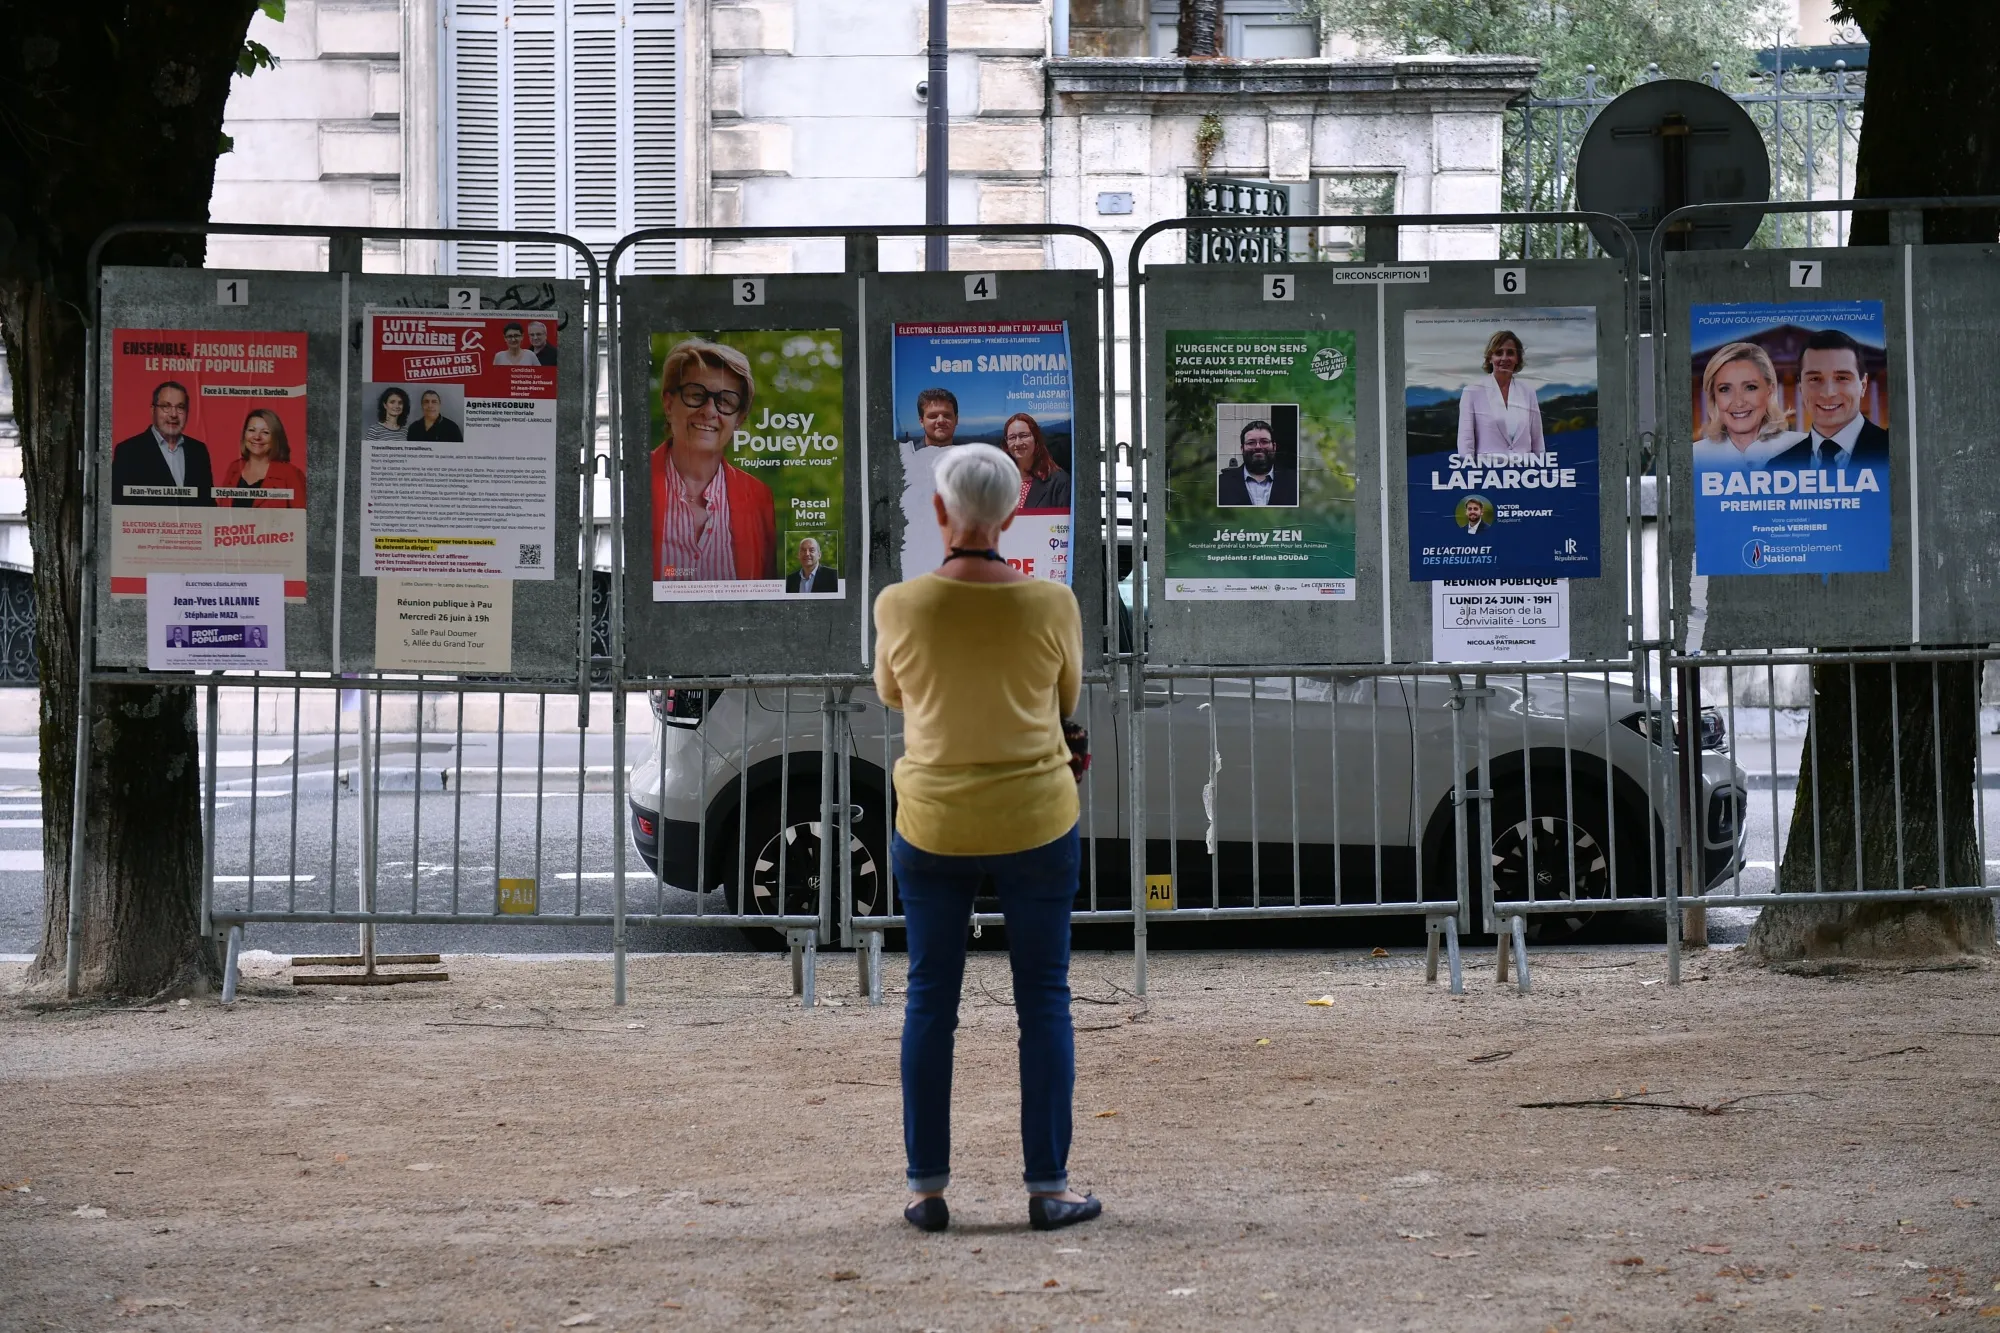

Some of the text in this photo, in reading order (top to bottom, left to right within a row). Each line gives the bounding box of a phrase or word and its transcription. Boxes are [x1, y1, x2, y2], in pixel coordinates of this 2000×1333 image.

[1336, 271, 1427, 280] CIRCONSCRIPTION 1
[1799, 265, 1813, 285] 7
[974, 277, 988, 297] 4
[1502, 272, 1517, 292] 6
[227, 282, 237, 302] 1
[742, 282, 756, 303] 3
[1272, 279, 1285, 298] 5
[457, 290, 472, 309] 2
[1735, 315, 1797, 324] GOUVERNEMENT
[1832, 313, 1875, 321] NATIONALE
[382, 320, 426, 332] LUTTE
[899, 325, 932, 334] ÉLECTIONS
[934, 325, 977, 334] LÉGISLATIVES
[1032, 324, 1036, 332] 7
[1038, 324, 1062, 332] JUILLET
[382, 331, 456, 345] OUVRIÈRE
[123, 342, 297, 358] ENSEMBLE, FAISONS GAGNER
[1238, 344, 1251, 352] DU
[1255, 344, 1277, 352] BON
[1280, 344, 1307, 352] SENS
[411, 355, 472, 367] LE CAMP DES
[931, 356, 973, 373] Jean
[1176, 355, 1294, 365] FACE AUX 3 EXTRÊMES
[145, 358, 275, 373] LE FRONT POPULAIRE
[407, 365, 477, 378] TRAVAILLEURS
[1201, 368, 1243, 376] République,
[218, 387, 222, 395] à
[264, 388, 288, 396] Bardella
[1007, 390, 1034, 400] Justine
[466, 401, 534, 410] Agnès HEGOBURU
[1028, 401, 1070, 412] Suppléante
[756, 408, 814, 434] Josy
[733, 430, 838, 456] Poueyto
[1449, 452, 1558, 469] SANDRINE
[1432, 469, 1576, 490] LAFARGUE
[1702, 468, 1880, 496] BARDELLA
[129, 488, 191, 496] Jean-Yves LALANNE
[216, 489, 248, 498] Stéphanie
[791, 498, 830, 508] Pascal
[1720, 498, 1860, 512] PREMIER MINISTRE
[795, 510, 826, 520] Mora
[1512, 509, 1553, 517] PROYART
[214, 524, 256, 536] FRONT
[1752, 525, 1785, 533] François
[1213, 529, 1302, 545] Jérémy ZEN
[1217, 542, 1238, 550] général
[1423, 547, 1435, 555] DE
[1480, 546, 1492, 554] ET
[1764, 544, 1842, 553] Rassemblement
[1207, 554, 1248, 562] Suppléante
[1423, 555, 1492, 565] DES RÉSULTATS
[1764, 554, 1806, 563] National
[1500, 578, 1558, 587] PUBLIQUE
[174, 597, 259, 606] Jean-Yves LALANNE
[397, 599, 430, 607] Réunion
[433, 599, 468, 609] publique
[470, 600, 475, 608] à
[1500, 596, 1525, 604] JUIN
[1534, 596, 1552, 604] 19H
[185, 611, 218, 620] Stéphanie
[1460, 606, 1542, 615] à la Maison de la
[400, 613, 436, 621] Mercredi
[450, 613, 465, 622] juin
[1456, 616, 1546, 625] Convivialité Lons
[192, 629, 218, 638] FRONT
[404, 639, 410, 647] 5,
[412, 639, 430, 647] Allée
[432, 639, 442, 647] du
[443, 640, 466, 648] Grand
[501, 889, 532, 904] PAU
[1146, 885, 1169, 899] AU
